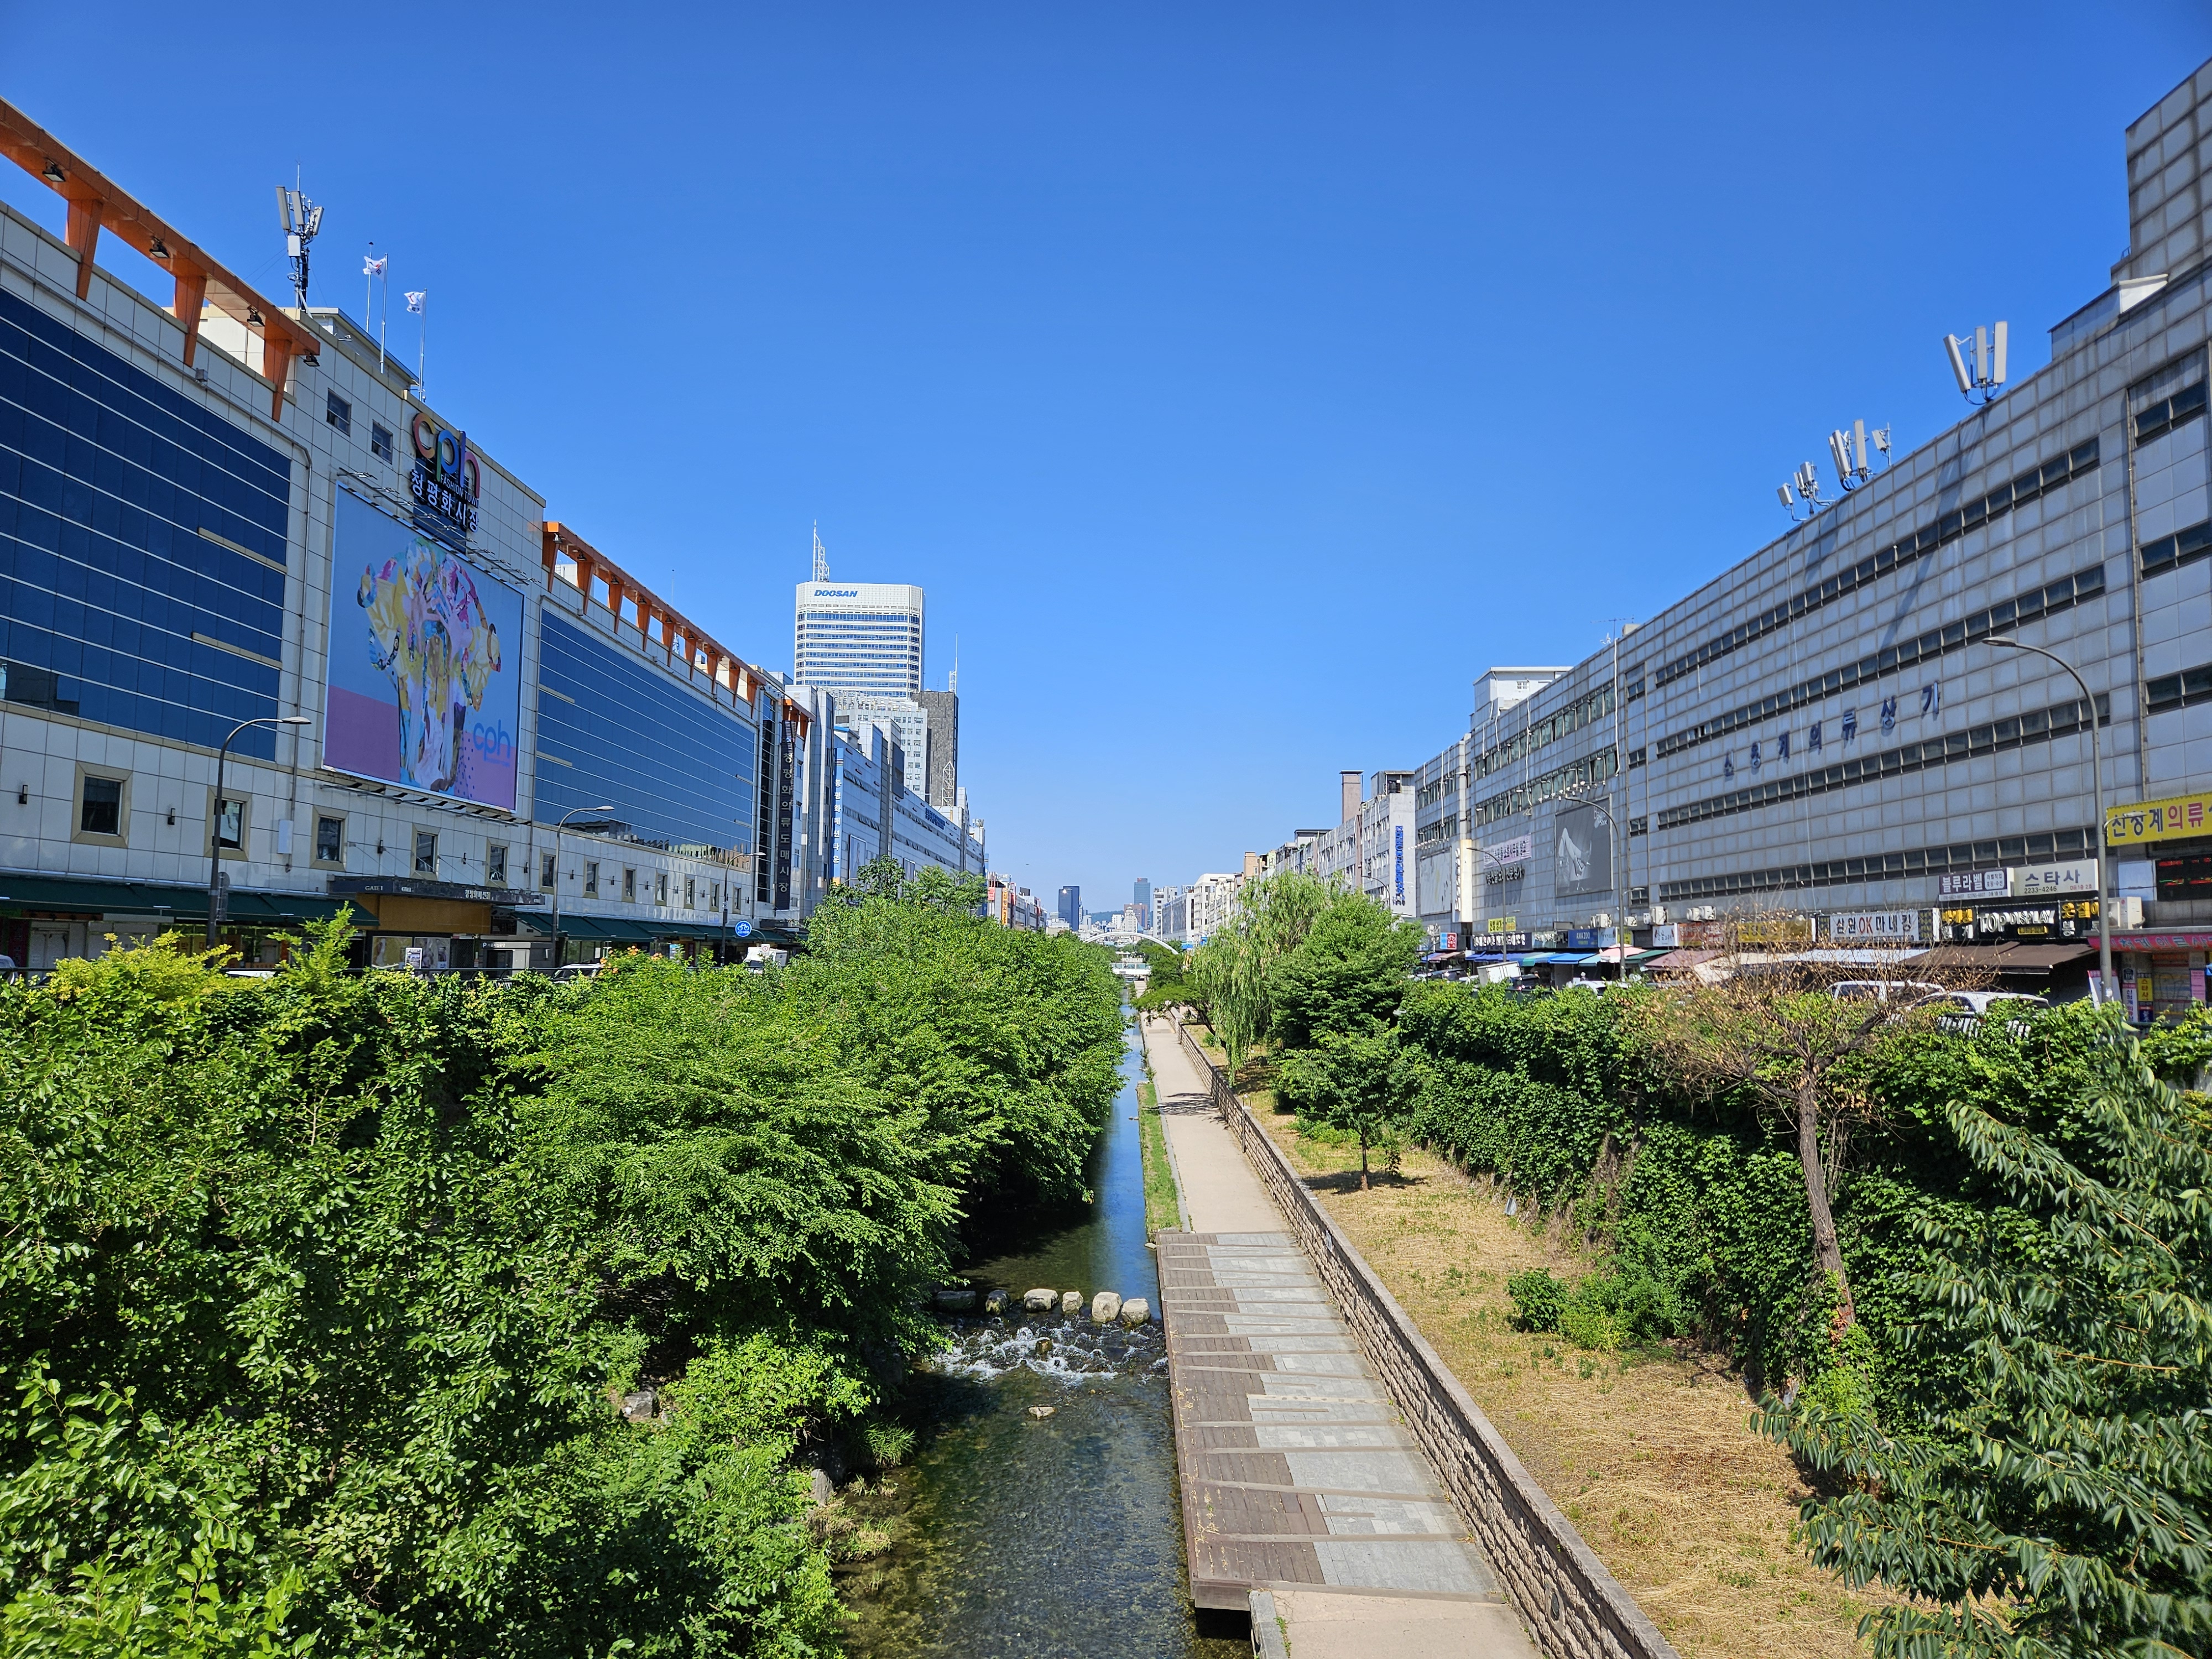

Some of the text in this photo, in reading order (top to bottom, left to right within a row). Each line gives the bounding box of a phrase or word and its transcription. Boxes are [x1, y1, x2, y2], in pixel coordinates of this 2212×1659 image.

[414, 413, 480, 498] cph
[411, 470, 479, 533] 청평화시장
[441, 474, 479, 509] FASHION TOWN
[473, 718, 510, 761] cph
[778, 753, 793, 893] 청평화의류도매시장
[832, 779, 842, 864] 동평화패션타운
[2112, 802, 2212, 838] 신청계의류
[1942, 873, 1983, 893] 블루라벨
[2024, 885, 2057, 894] 2233-4246
[2025, 869, 2080, 887] 스타사
[1978, 912, 2010, 932] TOP
[2010, 910, 2056, 925] DISPLAY
